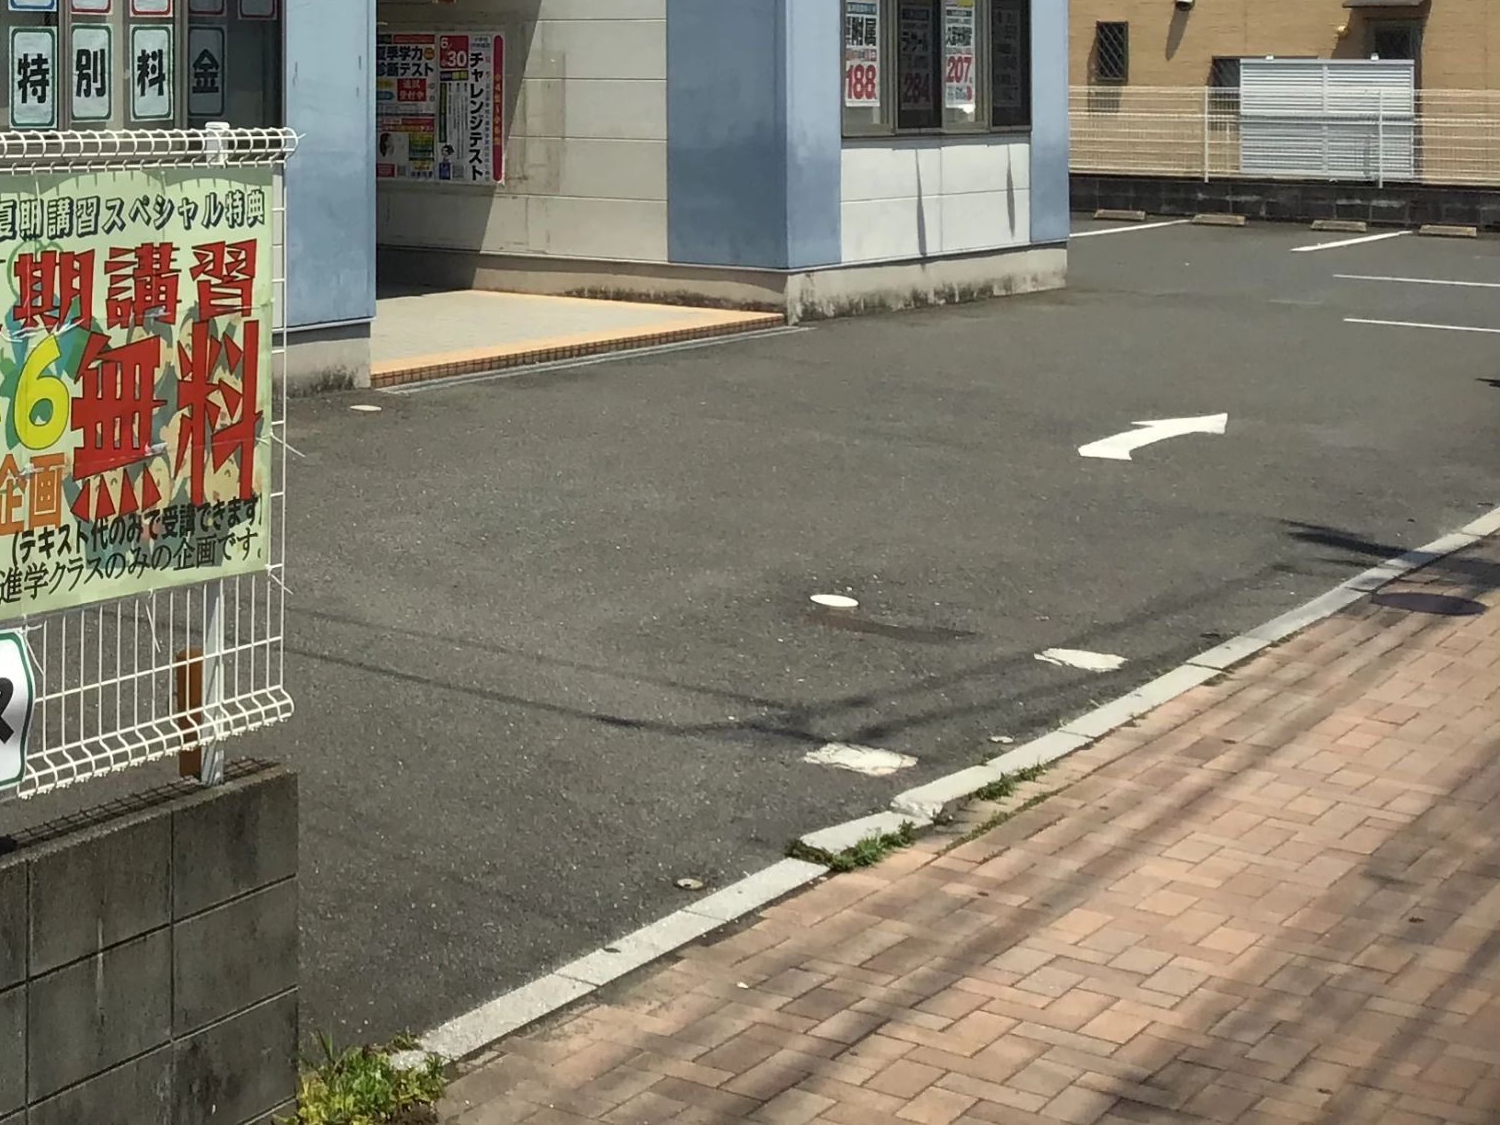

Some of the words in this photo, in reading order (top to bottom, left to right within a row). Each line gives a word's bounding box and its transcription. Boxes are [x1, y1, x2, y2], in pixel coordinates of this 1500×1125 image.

[469, 52, 484, 181] チャレンジテスト
[946, 56, 972, 83] 207
[70, 320, 263, 522] 無料
